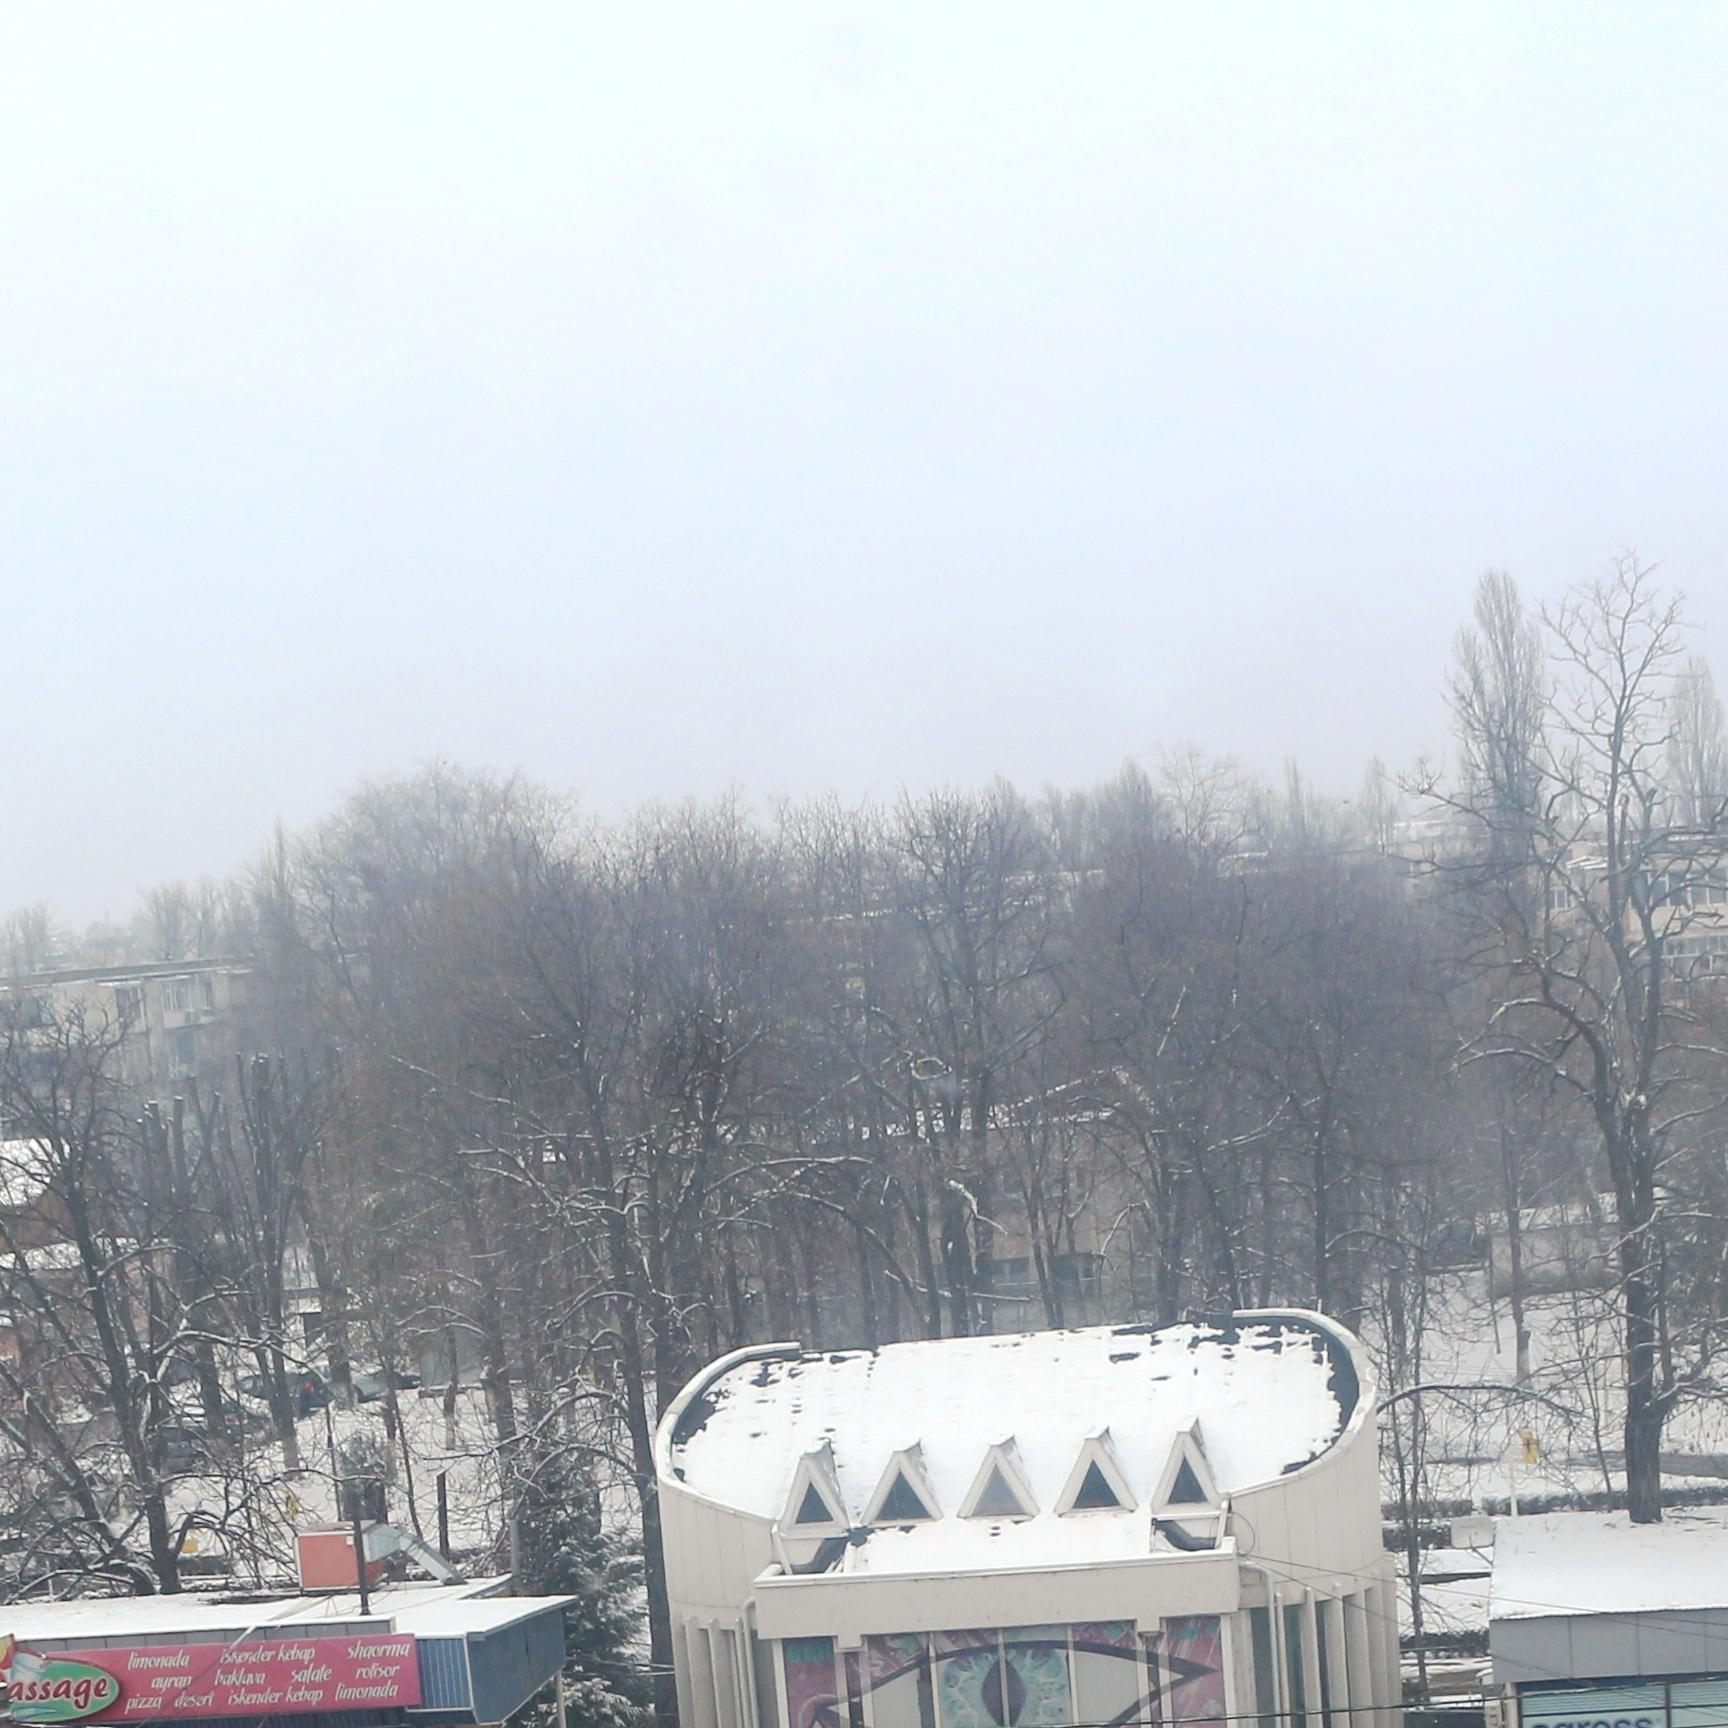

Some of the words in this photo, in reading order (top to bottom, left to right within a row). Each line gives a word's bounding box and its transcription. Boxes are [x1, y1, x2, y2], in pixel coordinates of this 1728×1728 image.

[127, 1649, 189, 1671] limonada
[220, 1647, 275, 1664] iskender
[277, 1644, 315, 1663] kebap
[347, 1640, 411, 1659] shaorma
[124, 1696, 162, 1715] pizza
[227, 1689, 280, 1706] iskender
[285, 1687, 323, 1705] kebap
[335, 1683, 398, 1701] limonada
[151, 1674, 192, 1693] ayran
